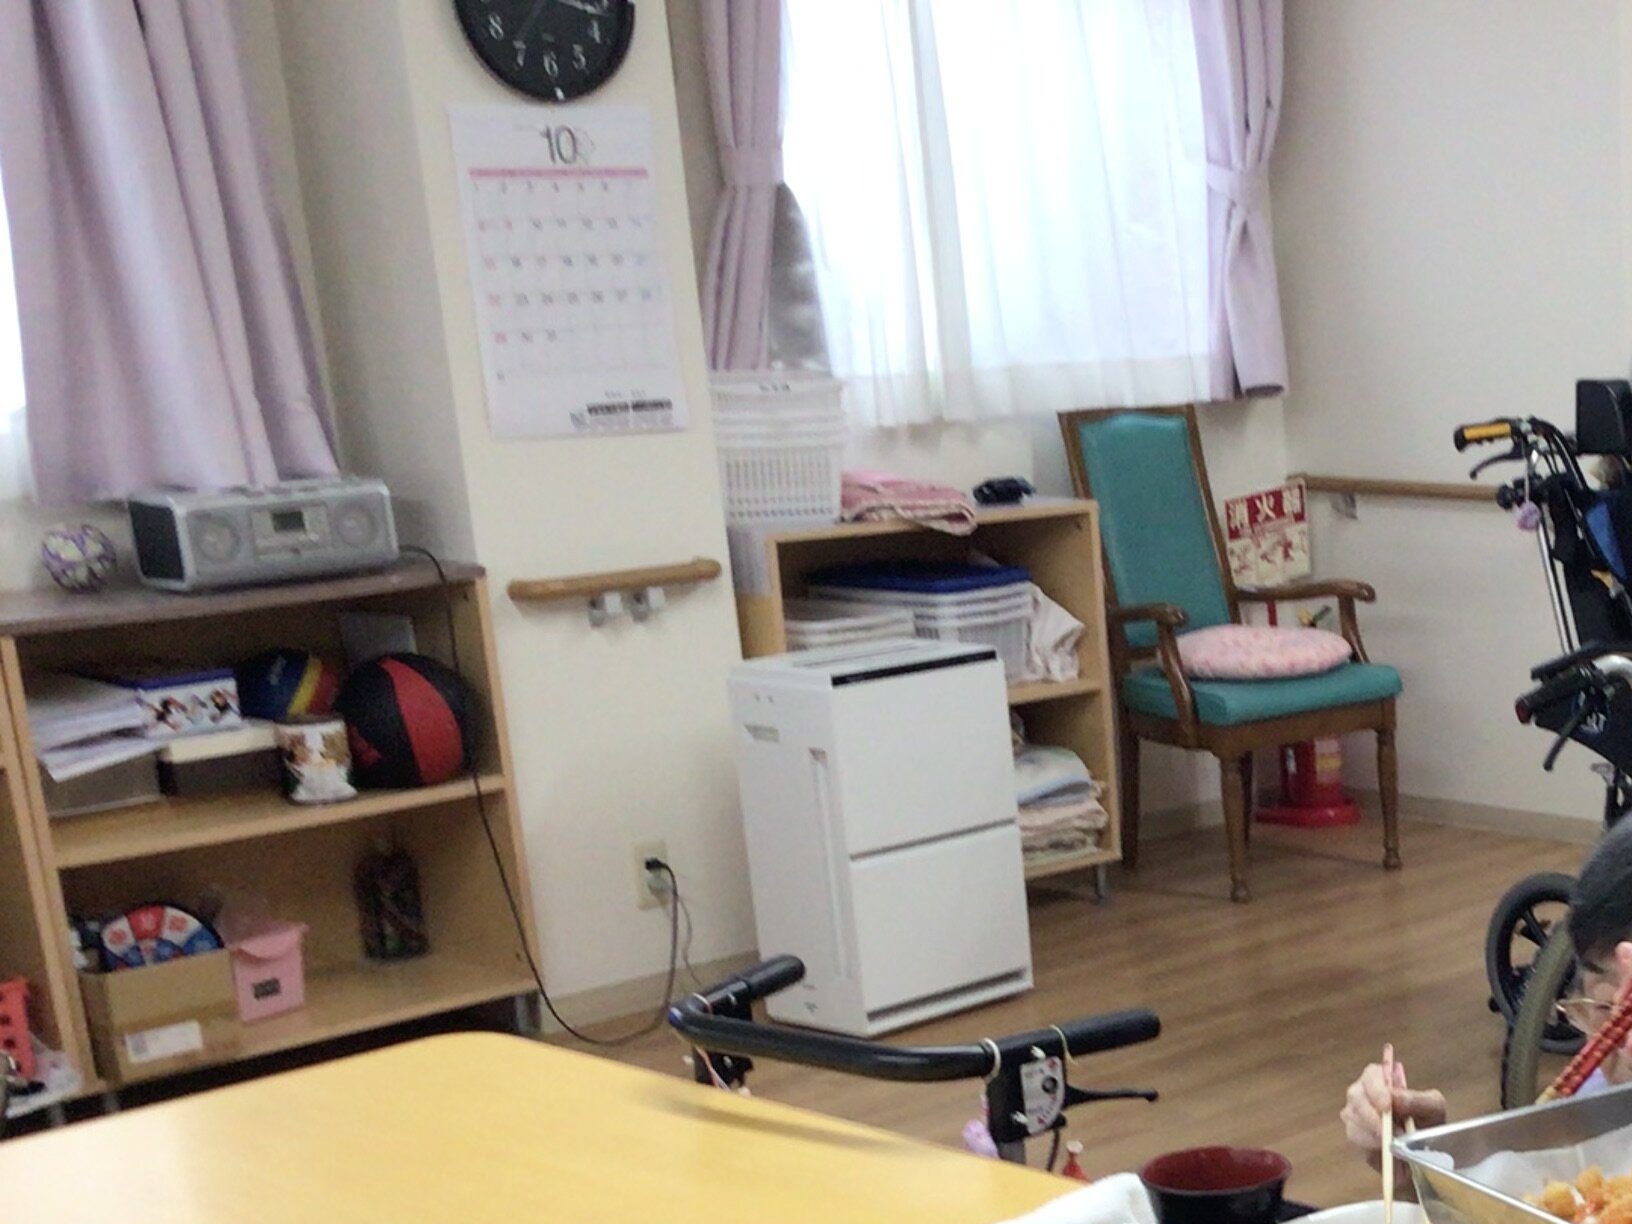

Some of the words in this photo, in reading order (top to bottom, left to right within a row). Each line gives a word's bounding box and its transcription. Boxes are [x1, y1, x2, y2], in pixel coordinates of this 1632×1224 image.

[488, 13, 503, 40] 8
[543, 50, 559, 78] 6
[540, 124, 579, 165] 10
